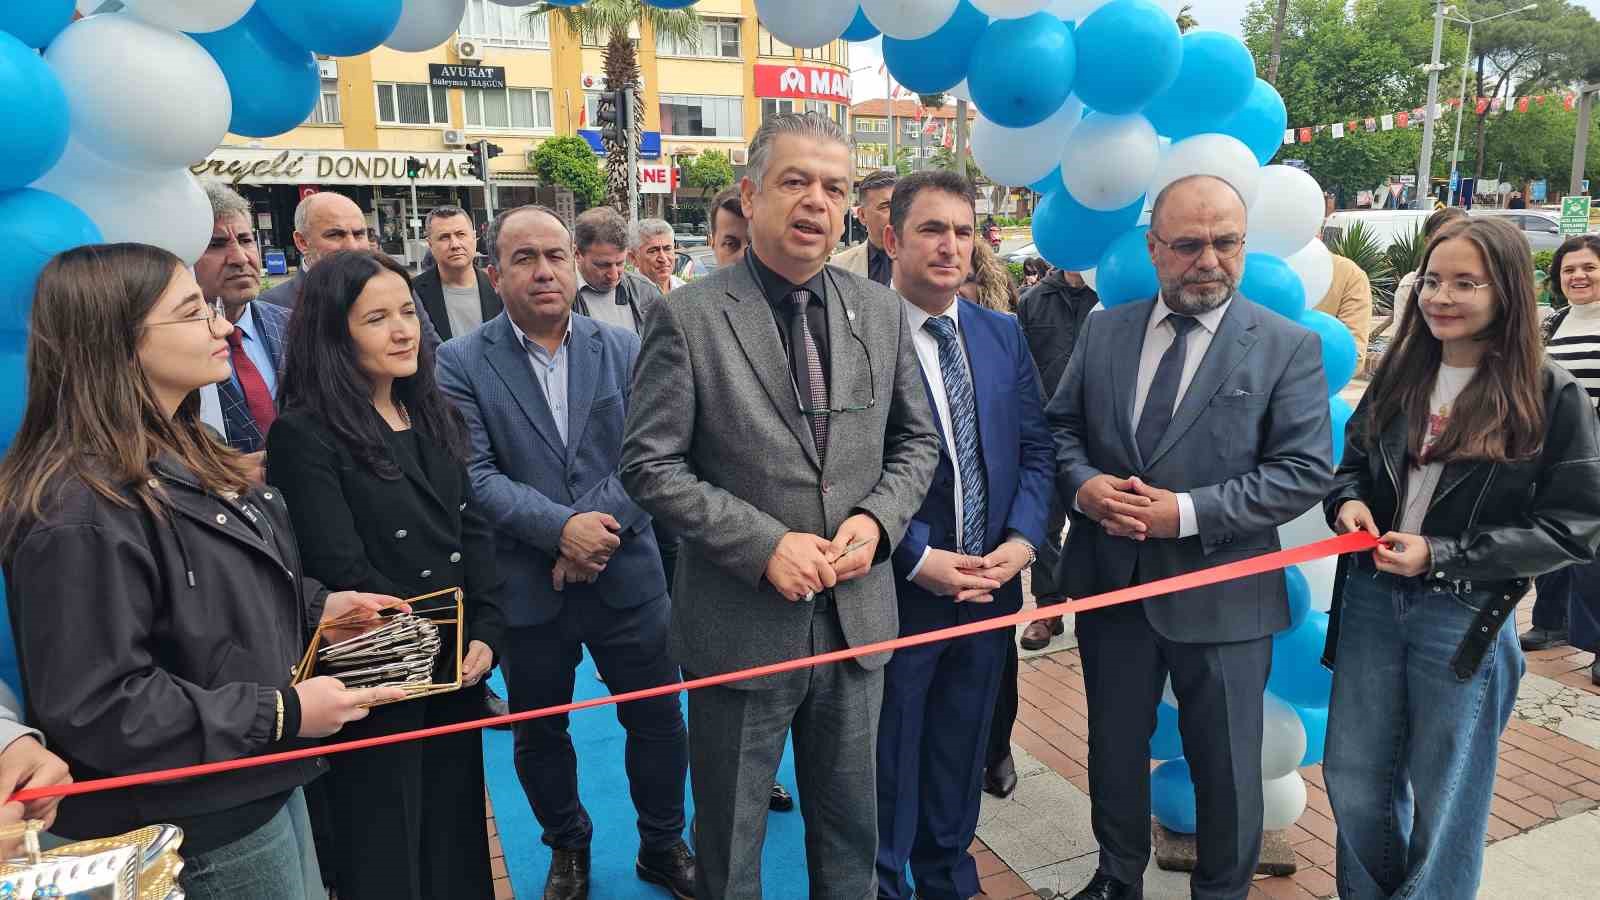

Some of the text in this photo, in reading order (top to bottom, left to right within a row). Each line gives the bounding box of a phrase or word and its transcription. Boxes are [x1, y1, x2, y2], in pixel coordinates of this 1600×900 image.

[441, 65, 495, 79] AVUKAT
[317, 155, 458, 179] DONDUMA
[638, 168, 667, 183] NE
